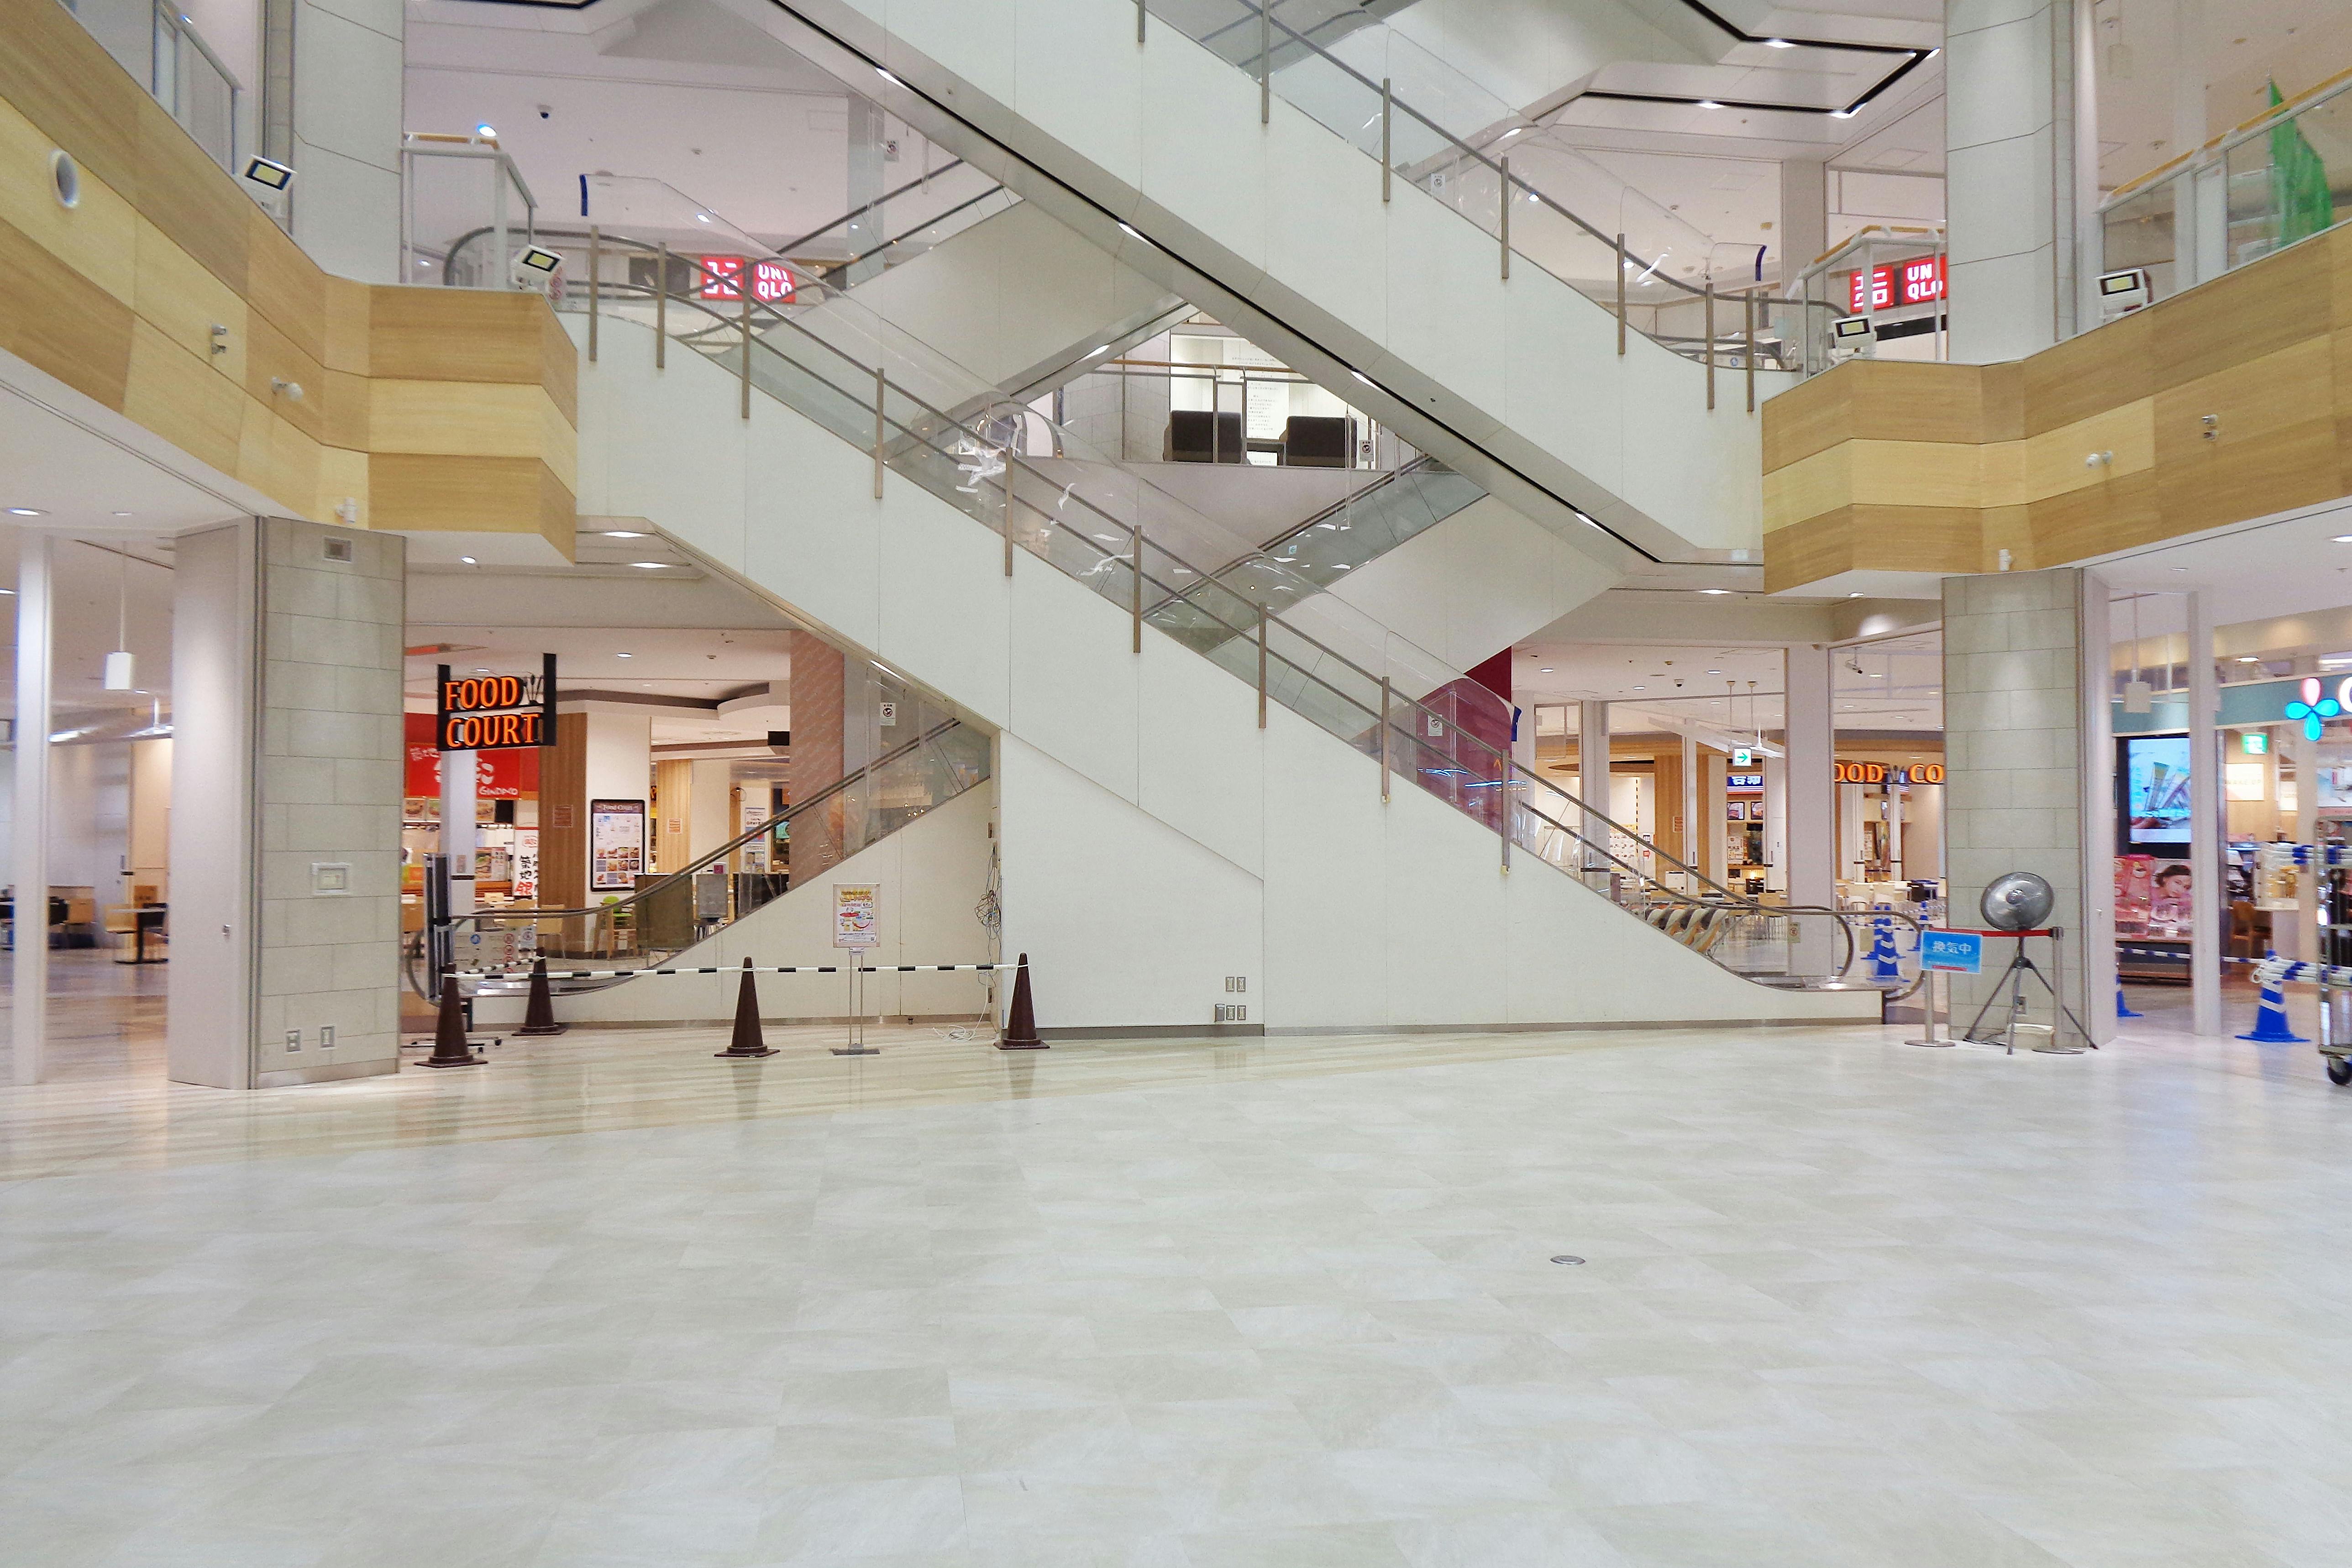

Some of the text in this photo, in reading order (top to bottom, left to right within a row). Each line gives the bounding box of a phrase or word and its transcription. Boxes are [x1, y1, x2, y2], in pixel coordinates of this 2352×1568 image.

[758, 264, 788, 281] UNI
[1907, 263, 1937, 281] UN
[758, 281, 793, 299] QLO
[445, 676, 519, 711] FOOD
[446, 713, 540, 748] COURT
[1834, 763, 1944, 782] OOD CO
